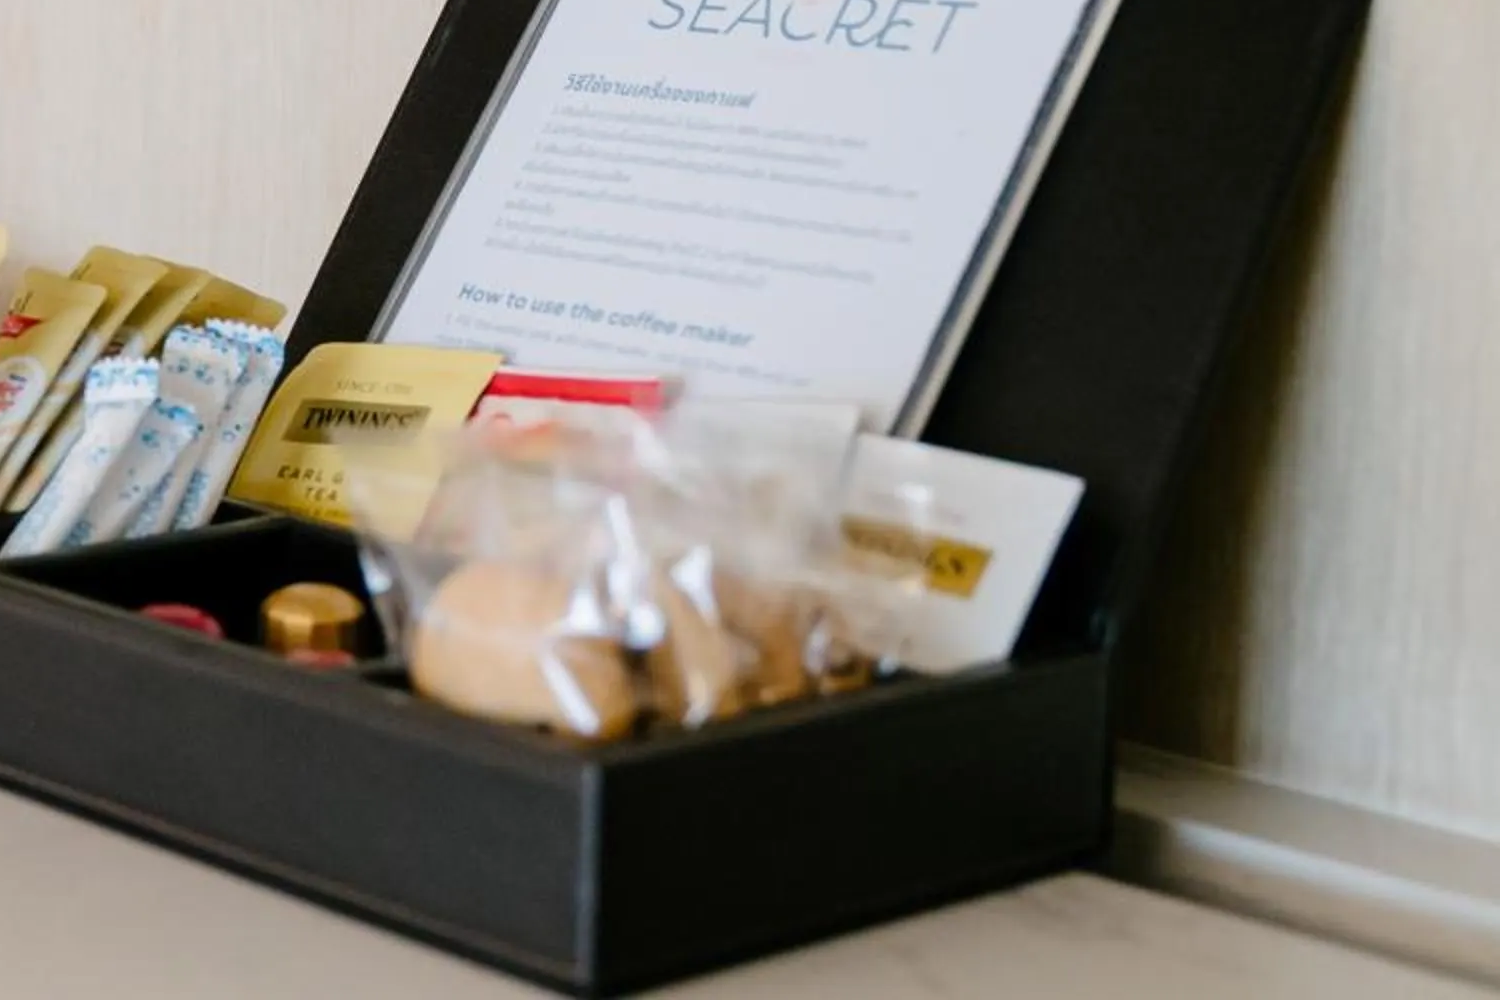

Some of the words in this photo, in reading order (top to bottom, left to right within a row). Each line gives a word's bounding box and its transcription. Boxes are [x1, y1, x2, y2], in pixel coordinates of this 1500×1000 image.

[457, 282, 503, 304] How
[505, 290, 527, 311] to
[530, 297, 566, 317] use
[569, 300, 604, 323] the
[607, 309, 679, 337] coffee
[680, 320, 755, 347] maker
[277, 464, 324, 483] EARL
[304, 486, 338, 502] TEA
